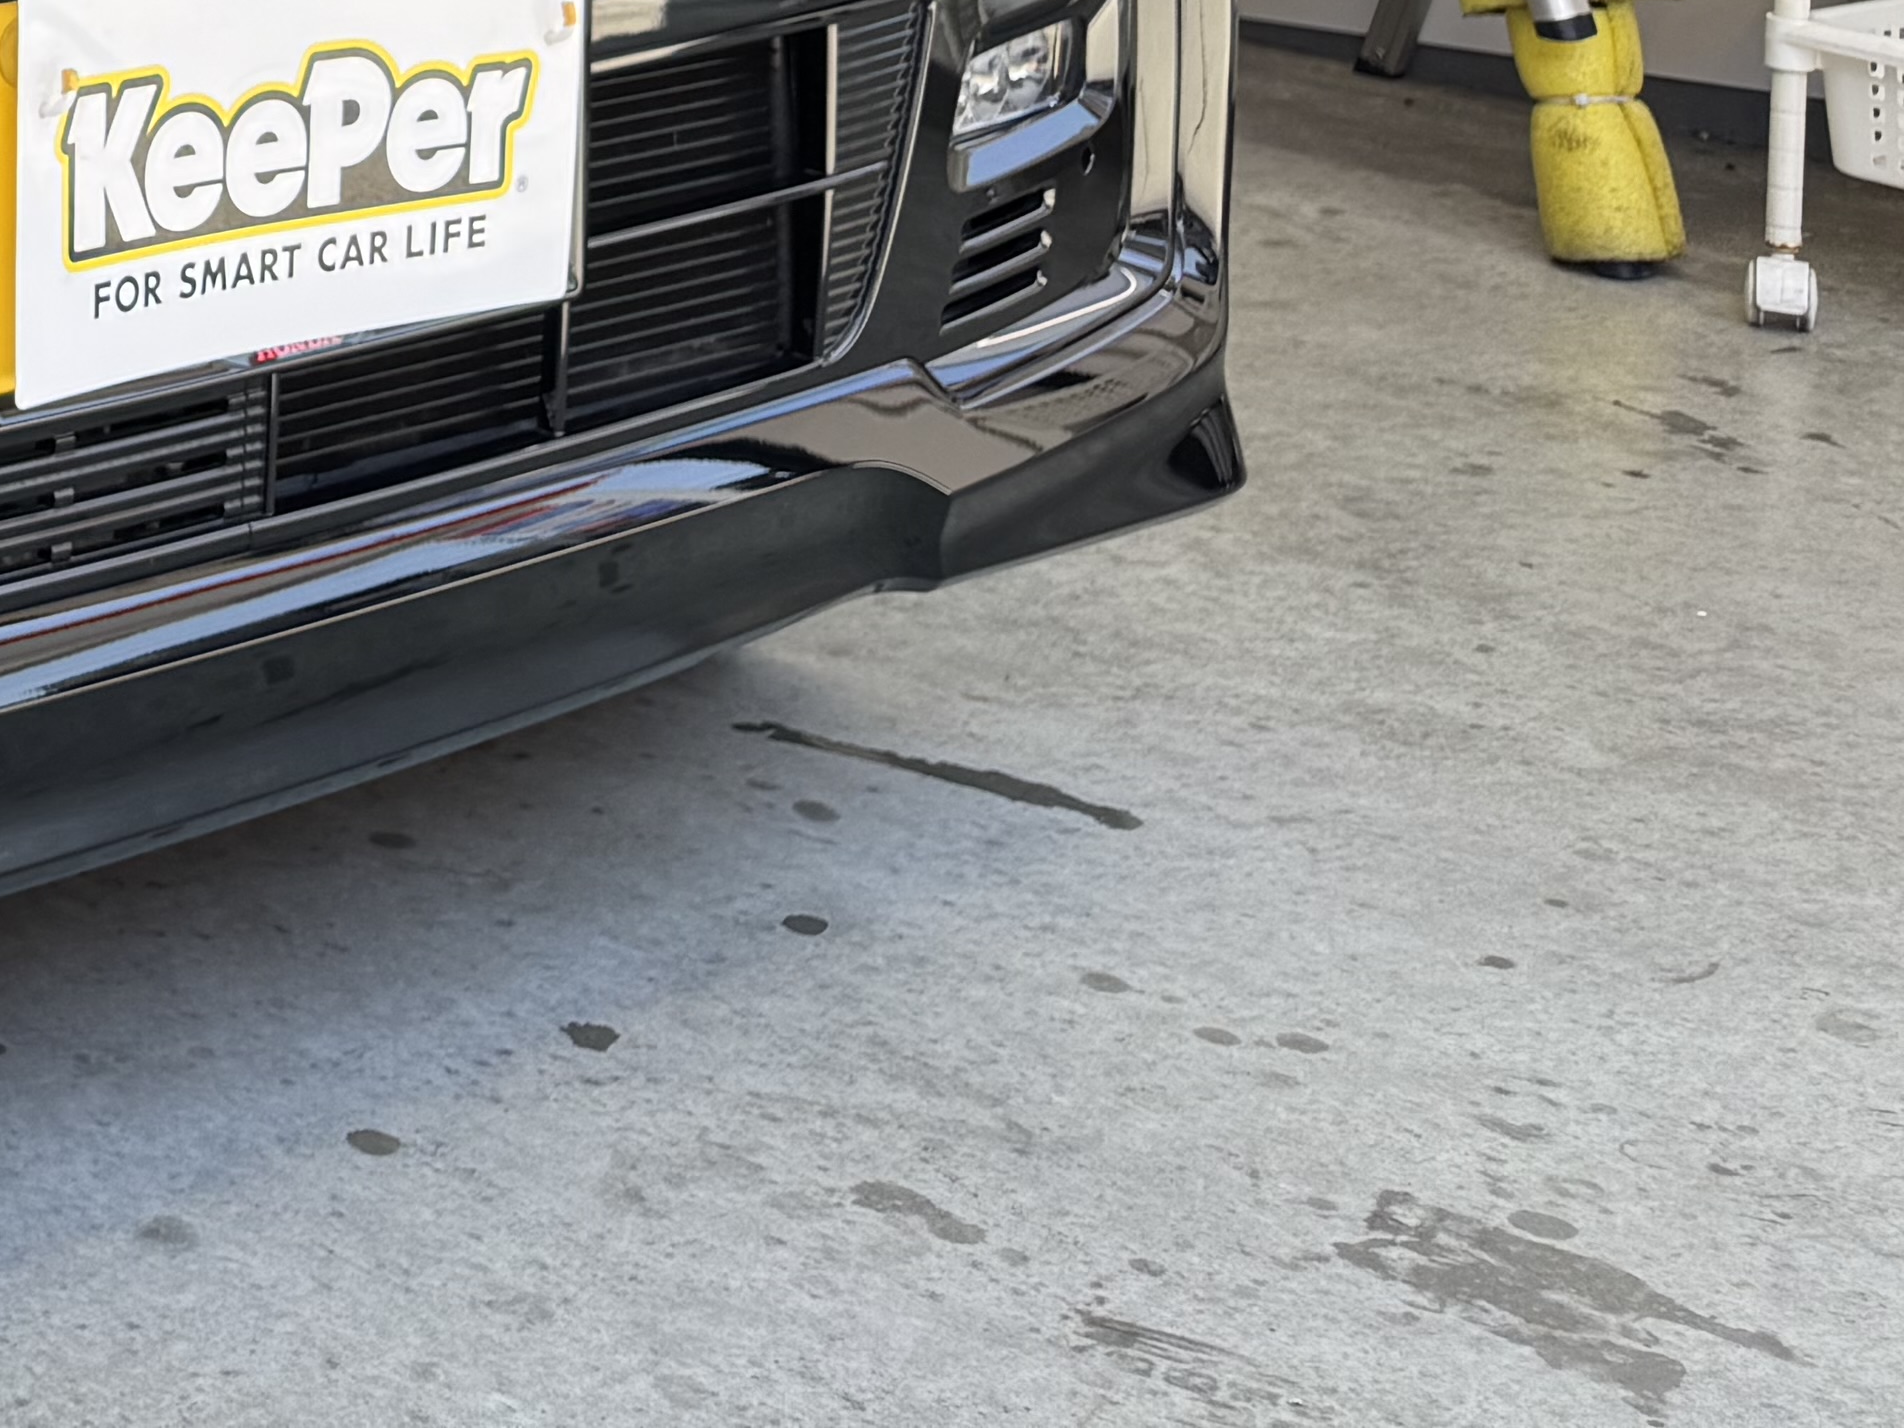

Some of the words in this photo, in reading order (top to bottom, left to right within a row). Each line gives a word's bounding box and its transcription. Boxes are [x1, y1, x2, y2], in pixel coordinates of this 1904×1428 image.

[63, 48, 533, 263] KeePer
[92, 270, 162, 319] FOR
[179, 243, 302, 299] SMART
[317, 230, 388, 272] CAR
[405, 214, 487, 259] LIFE
